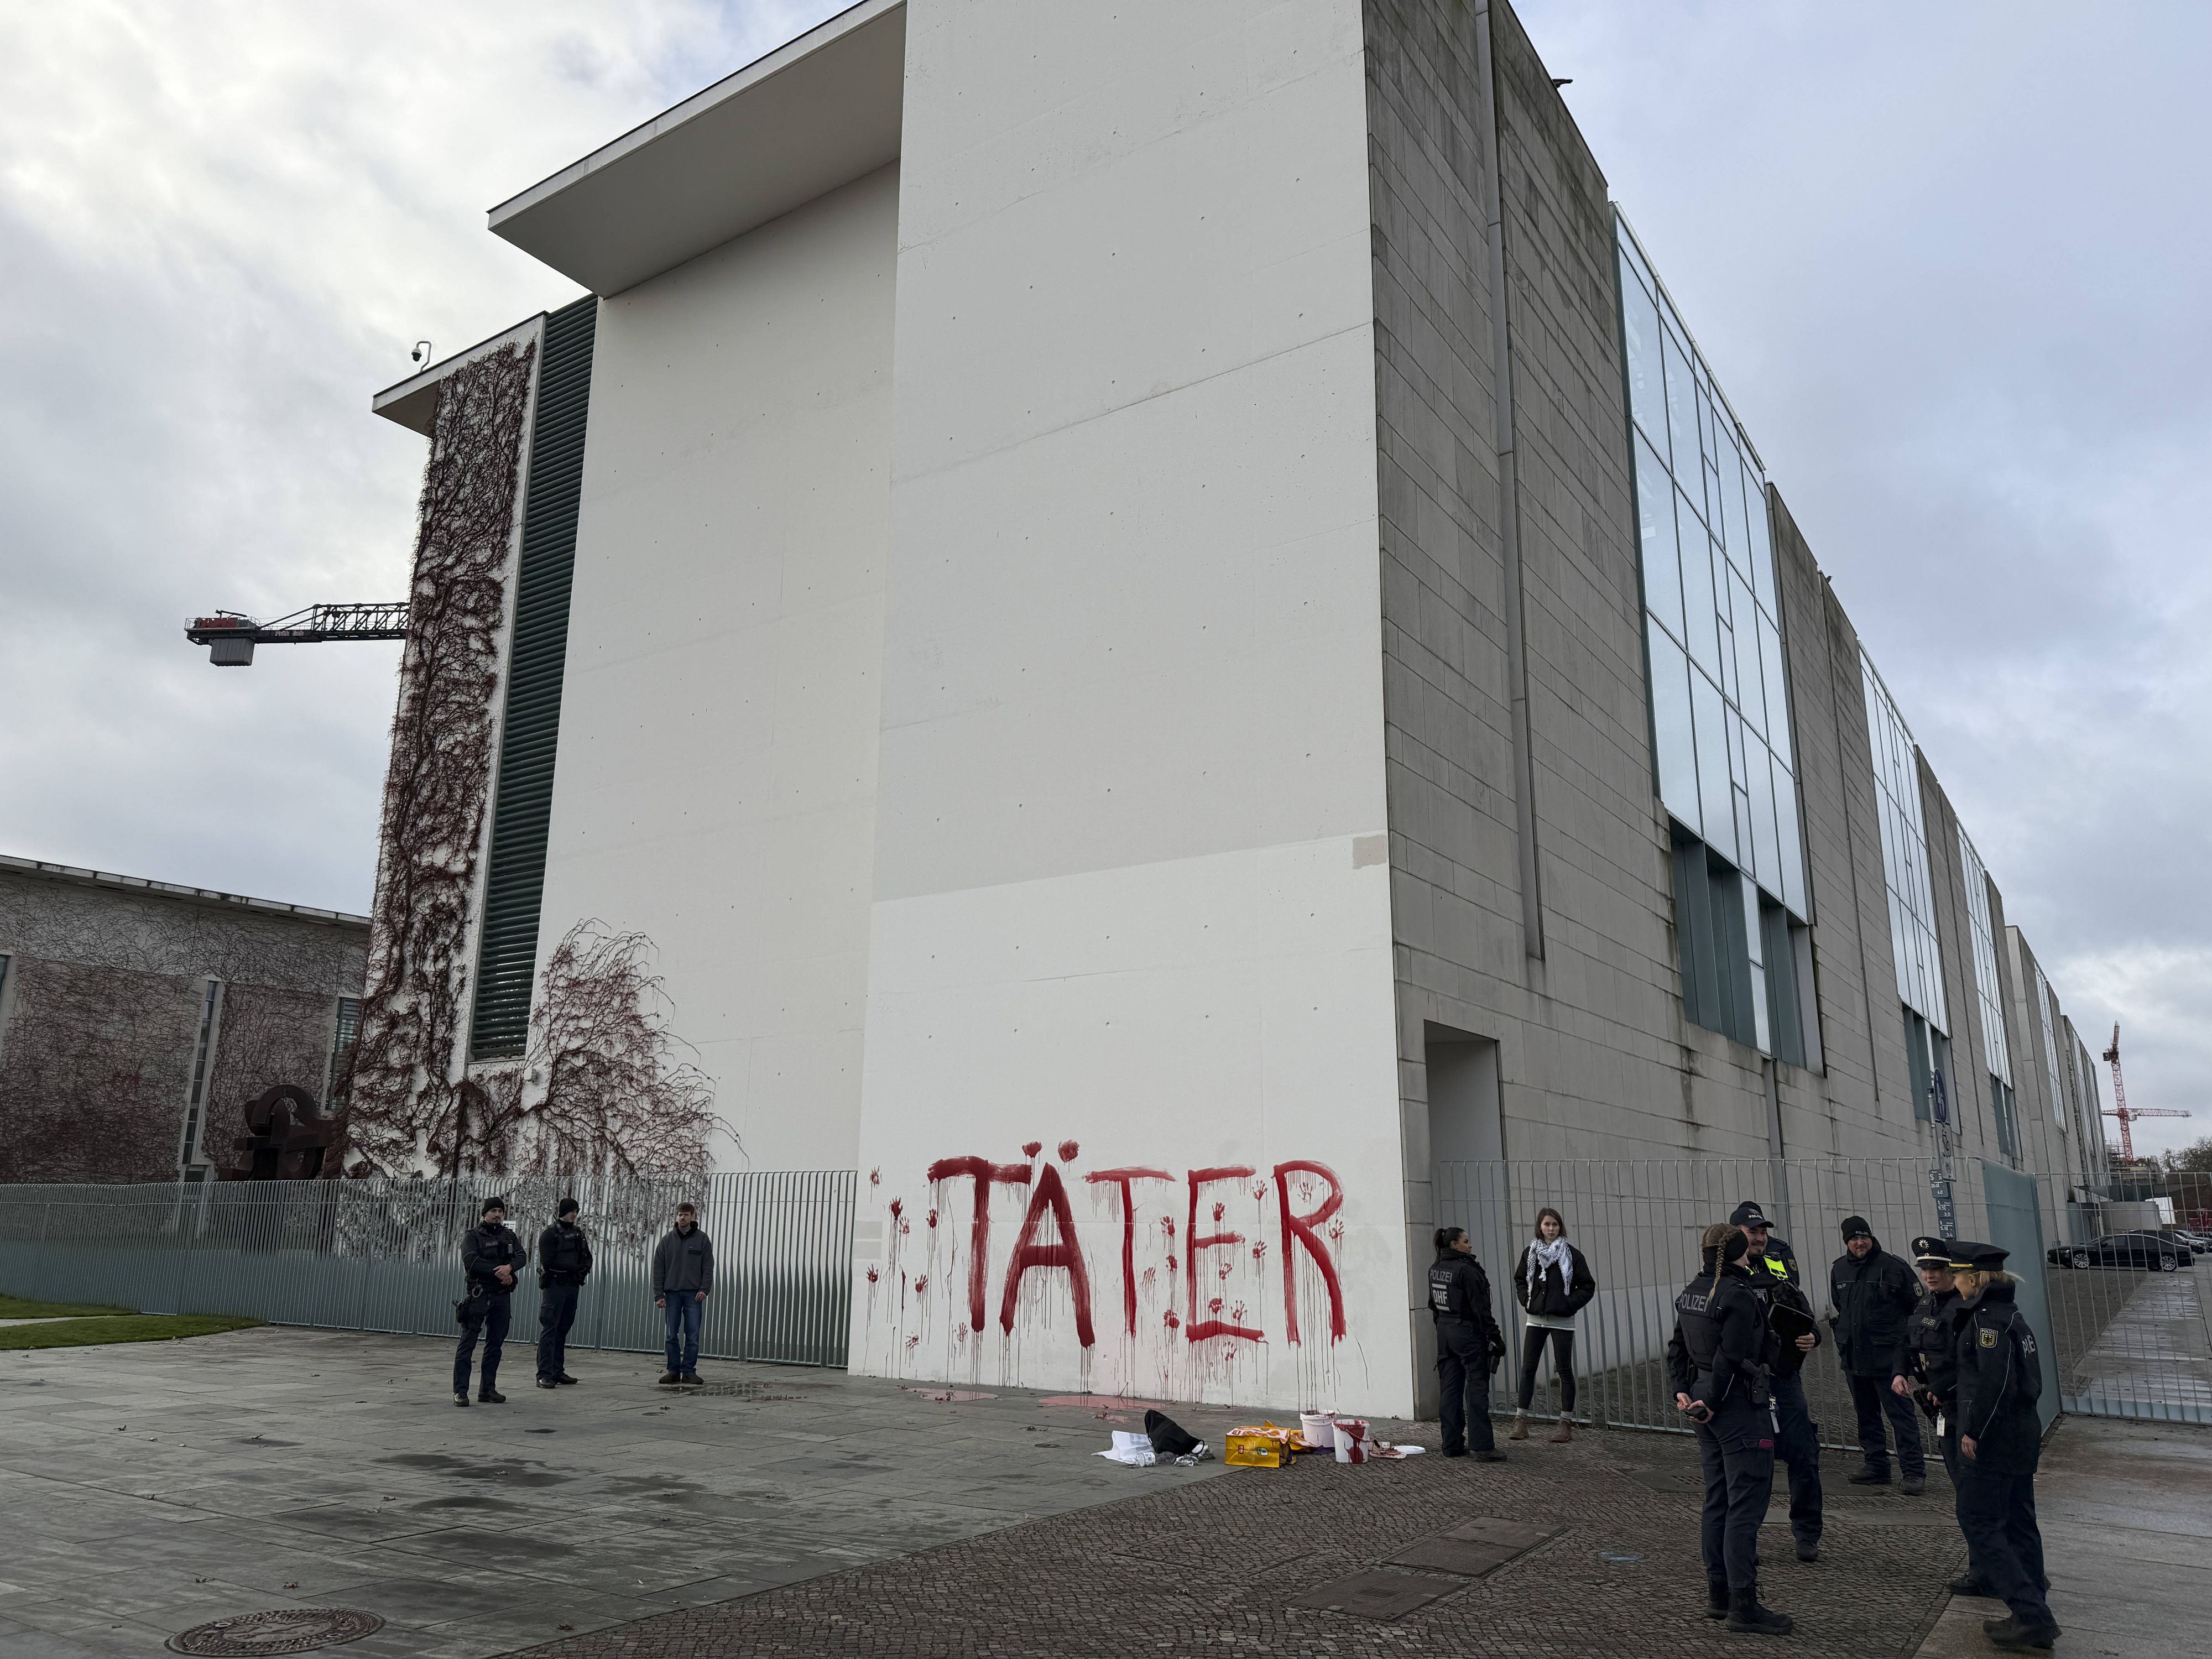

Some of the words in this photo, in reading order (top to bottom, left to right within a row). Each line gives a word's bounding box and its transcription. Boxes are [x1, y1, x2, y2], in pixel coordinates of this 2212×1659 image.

[927, 1139, 1347, 1348] TÄTER
[1430, 1269, 1453, 1283] POLIZEI
[1433, 1290, 1447, 1304] DHF
